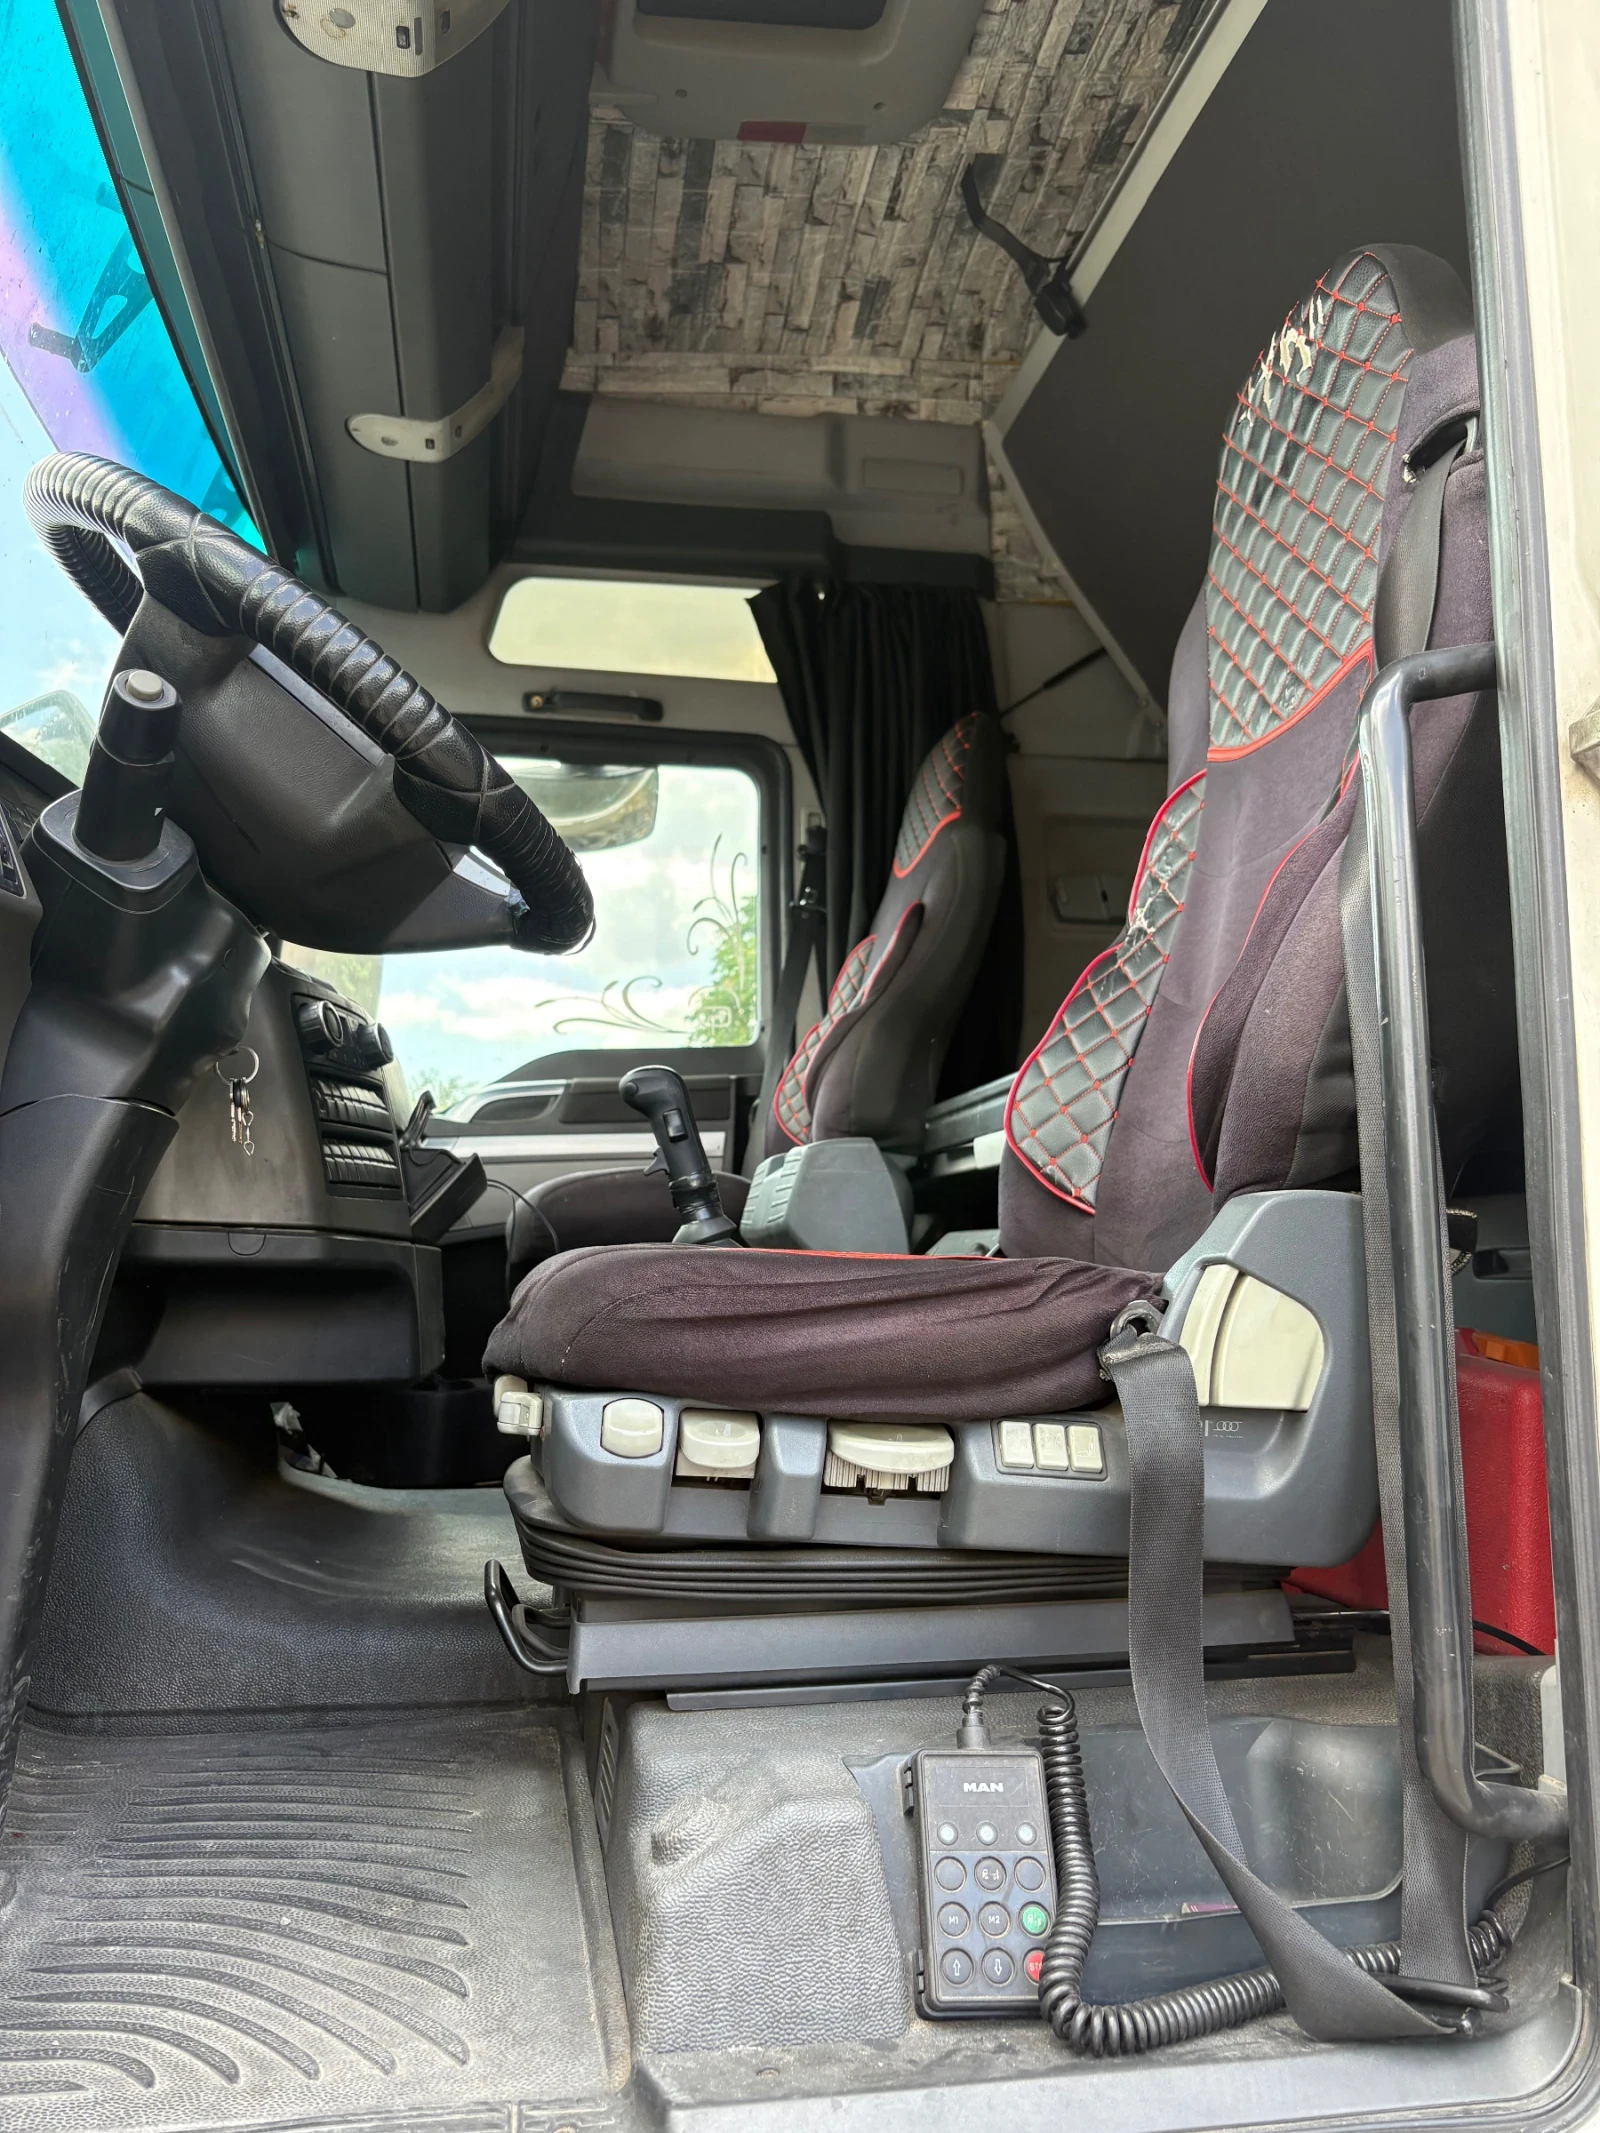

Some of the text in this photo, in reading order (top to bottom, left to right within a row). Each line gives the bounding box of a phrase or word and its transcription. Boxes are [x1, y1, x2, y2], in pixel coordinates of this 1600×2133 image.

[963, 1782, 1004, 1792] MAN
[948, 1915, 959, 1925] M1
[988, 1915, 1001, 1924] M2
